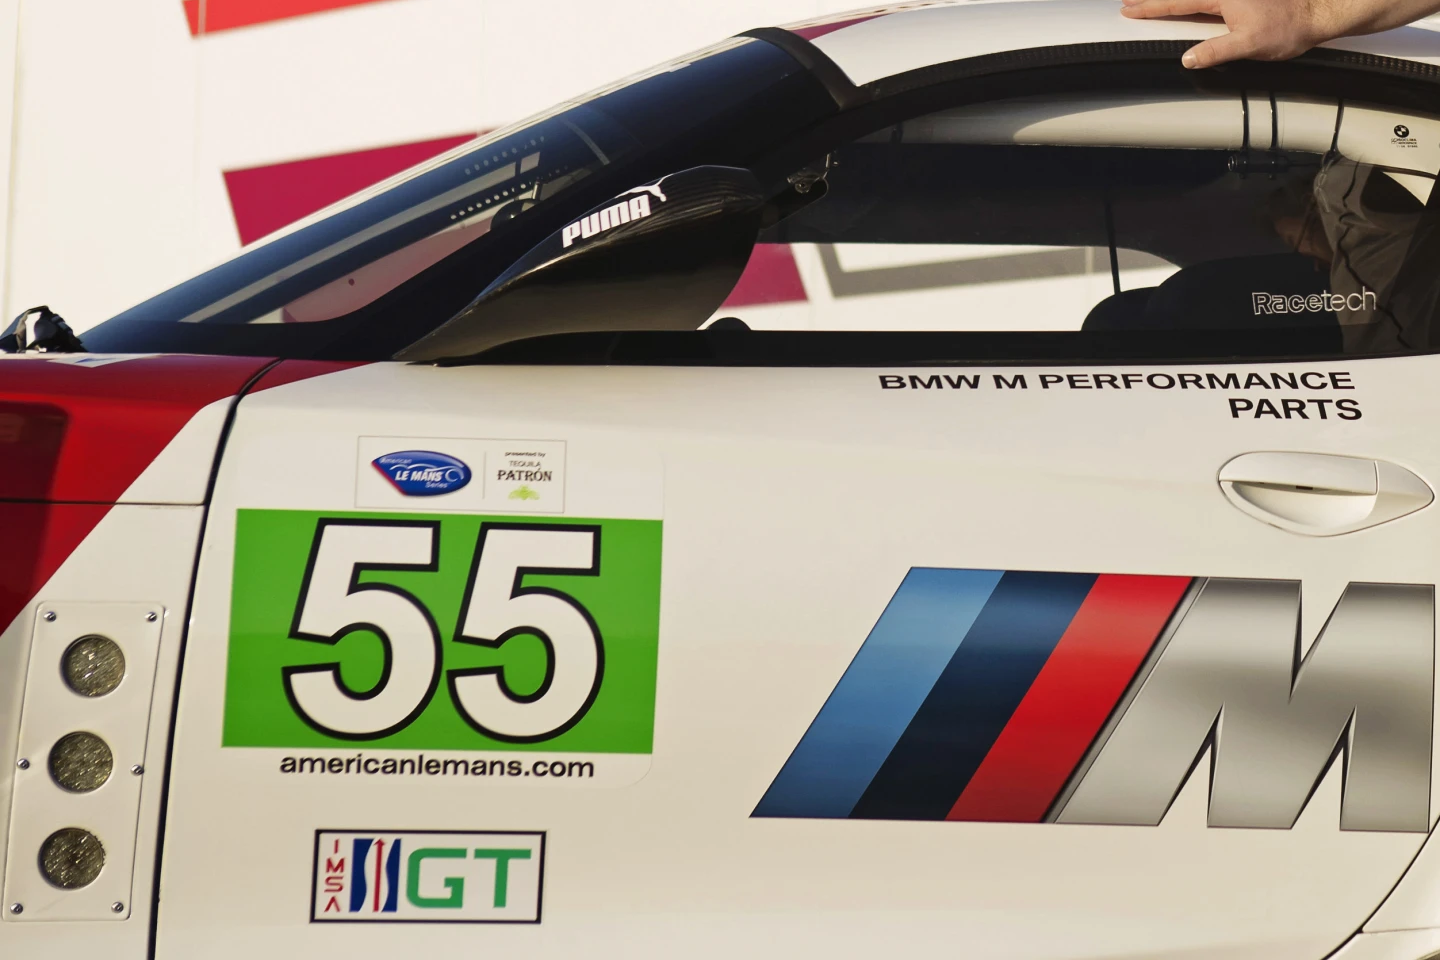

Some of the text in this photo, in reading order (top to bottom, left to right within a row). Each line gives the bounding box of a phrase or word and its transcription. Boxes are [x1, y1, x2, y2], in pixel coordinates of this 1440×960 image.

[562, 194, 652, 248] PUMA
[1252, 286, 1376, 315] Racetech
[878, 372, 1357, 390] BMW M PERFORMANCE
[1228, 398, 1363, 420] PARTS
[497, 467, 553, 482] PATRÓN
[509, 460, 541, 468] TEQUILA
[394, 470, 444, 482] LE MANS
[425, 481, 449, 489] Series
[281, 517, 606, 743] 55
[1044, 576, 1436, 833] M
[279, 753, 595, 778] americanlemans.com
[324, 838, 532, 913] IMSA GT
